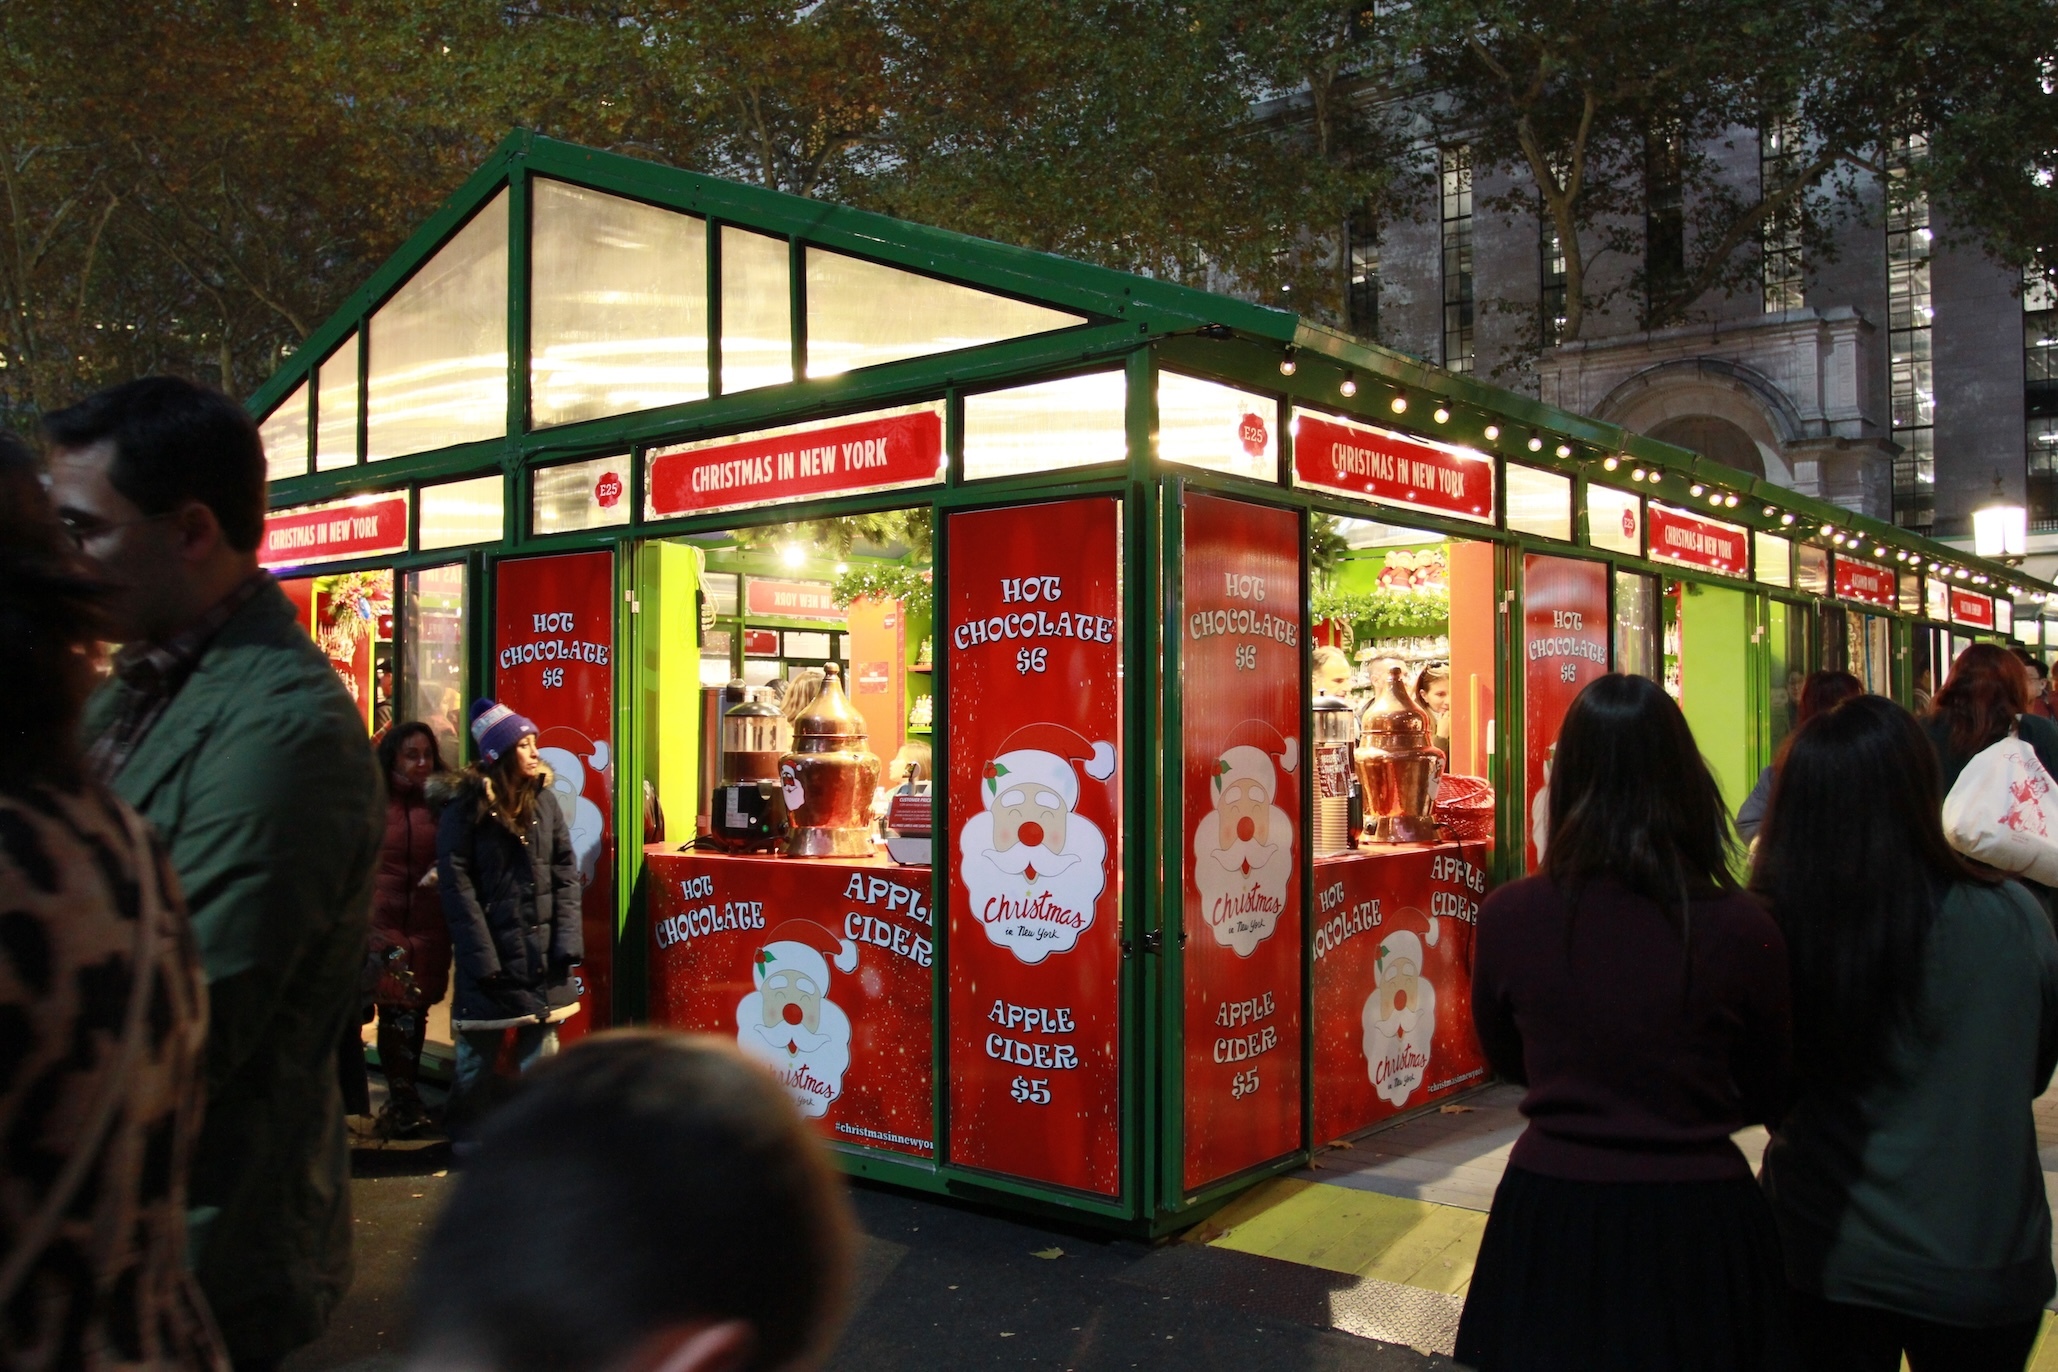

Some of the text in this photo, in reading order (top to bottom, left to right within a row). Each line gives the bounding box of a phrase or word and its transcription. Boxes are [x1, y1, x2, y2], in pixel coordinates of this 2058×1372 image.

[1244, 426, 1263, 443] E25
[692, 437, 887, 493] CHRISTMAS IN NEW YORK
[1331, 442, 1465, 497] CHRISTMAS IN NEW YORK
[600, 482, 618, 497] E25
[269, 515, 378, 550] CHRISTMAS IN NEW YORK
[1624, 517, 1634, 529] E25
[1664, 525, 1696, 551] CHRISTMAS
[1704, 535, 1717, 557] NEW
[1718, 538, 1732, 560] YORK
[1000, 575, 1062, 603] HOT
[1224, 572, 1265, 602] HOT
[532, 612, 575, 633] HOT
[954, 610, 1114, 650] CHOCOLATE
[1189, 608, 1297, 647] CHOCOLATE
[1552, 610, 1583, 631] HOT
[500, 639, 609, 670] CHOCOLATE
[1015, 646, 1048, 675] $6
[1235, 642, 1257, 671] $6
[1528, 637, 1606, 665] CHOCOLATE
[542, 667, 564, 689] $6
[1560, 662, 1577, 683] $6
[680, 875, 714, 900] HOT
[1430, 854, 1486, 894] APPLE
[984, 890, 1086, 928] Christmas
[1212, 882, 1281, 926] Christmas
[1319, 881, 1345, 913] HOT
[1431, 890, 1479, 926] CIDER
[655, 901, 766, 950] CHOCOLATE
[844, 911, 933, 967] CIDER
[1017, 925, 1035, 937] New
[1036, 927, 1061, 941] York
[1312, 899, 1382, 962] OCOLATE
[987, 999, 1076, 1033] APPLE
[1215, 991, 1276, 1028] APPLE
[985, 1033, 1079, 1070] CIDER
[1213, 1025, 1278, 1064] CIDER
[768, 1064, 835, 1098] hristmas
[1375, 1043, 1428, 1085] Christmas
[1010, 1075, 1052, 1105] $5
[1231, 1066, 1261, 1100] $5
